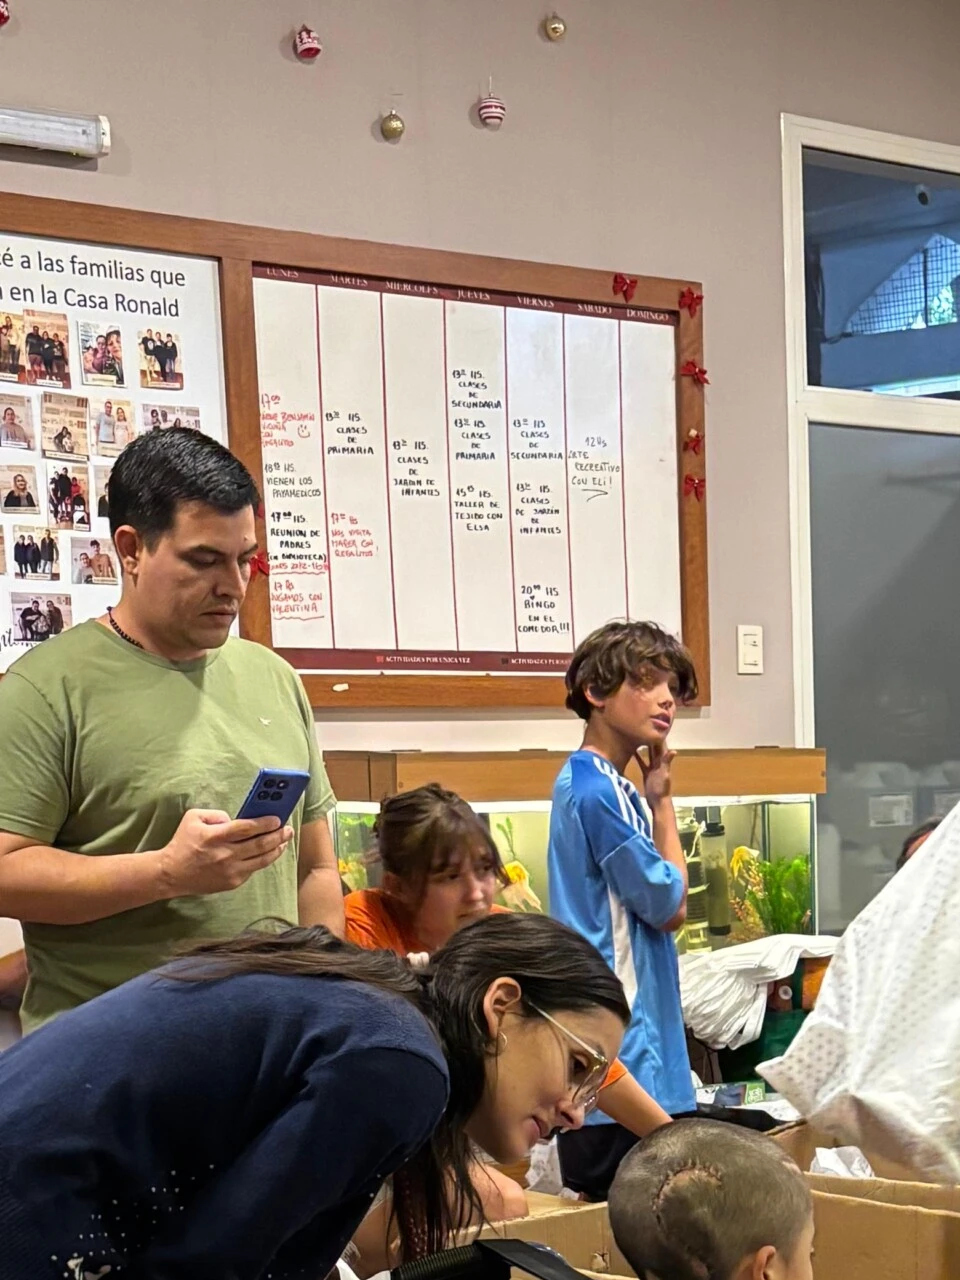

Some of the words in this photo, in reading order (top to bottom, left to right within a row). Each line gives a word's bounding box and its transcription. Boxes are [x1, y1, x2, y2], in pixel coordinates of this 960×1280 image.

[20, 254, 31, 269] a
[38, 251, 65, 273] las
[70, 255, 145, 282] familias
[150, 269, 186, 289] que
[266, 268, 299, 278] LUNES
[331, 275, 369, 287] MARTES
[457, 289, 491, 301] JUEVES
[517, 296, 555, 309] VIERNES
[626, 308, 670, 321] DOMINGO
[10, 286, 34, 303] en
[41, 284, 57, 304] la
[64, 288, 109, 310] Casa
[115, 293, 180, 317] Ronald
[458, 381, 487, 390] CLASES
[452, 400, 502, 409] SECUNDARIA
[461, 432, 491, 440] CLASES
[520, 431, 550, 439] CLASES
[327, 446, 374, 455] PRIMARIA
[455, 452, 496, 460] PRIMARIA
[510, 452, 563, 460] SECUNDARIA
[266, 477, 295, 486] VIENEN
[299, 476, 313, 485] LOS
[272, 488, 321, 498] PAYAMEDICOS
[401, 488, 440, 496] INFANTES
[455, 512, 484, 520] TEJIDO
[486, 512, 503, 520] CON
[466, 523, 490, 531] ELSA
[310, 530, 320, 538] DE
[279, 540, 311, 549] PADRES
[524, 600, 556, 609] BINGO
